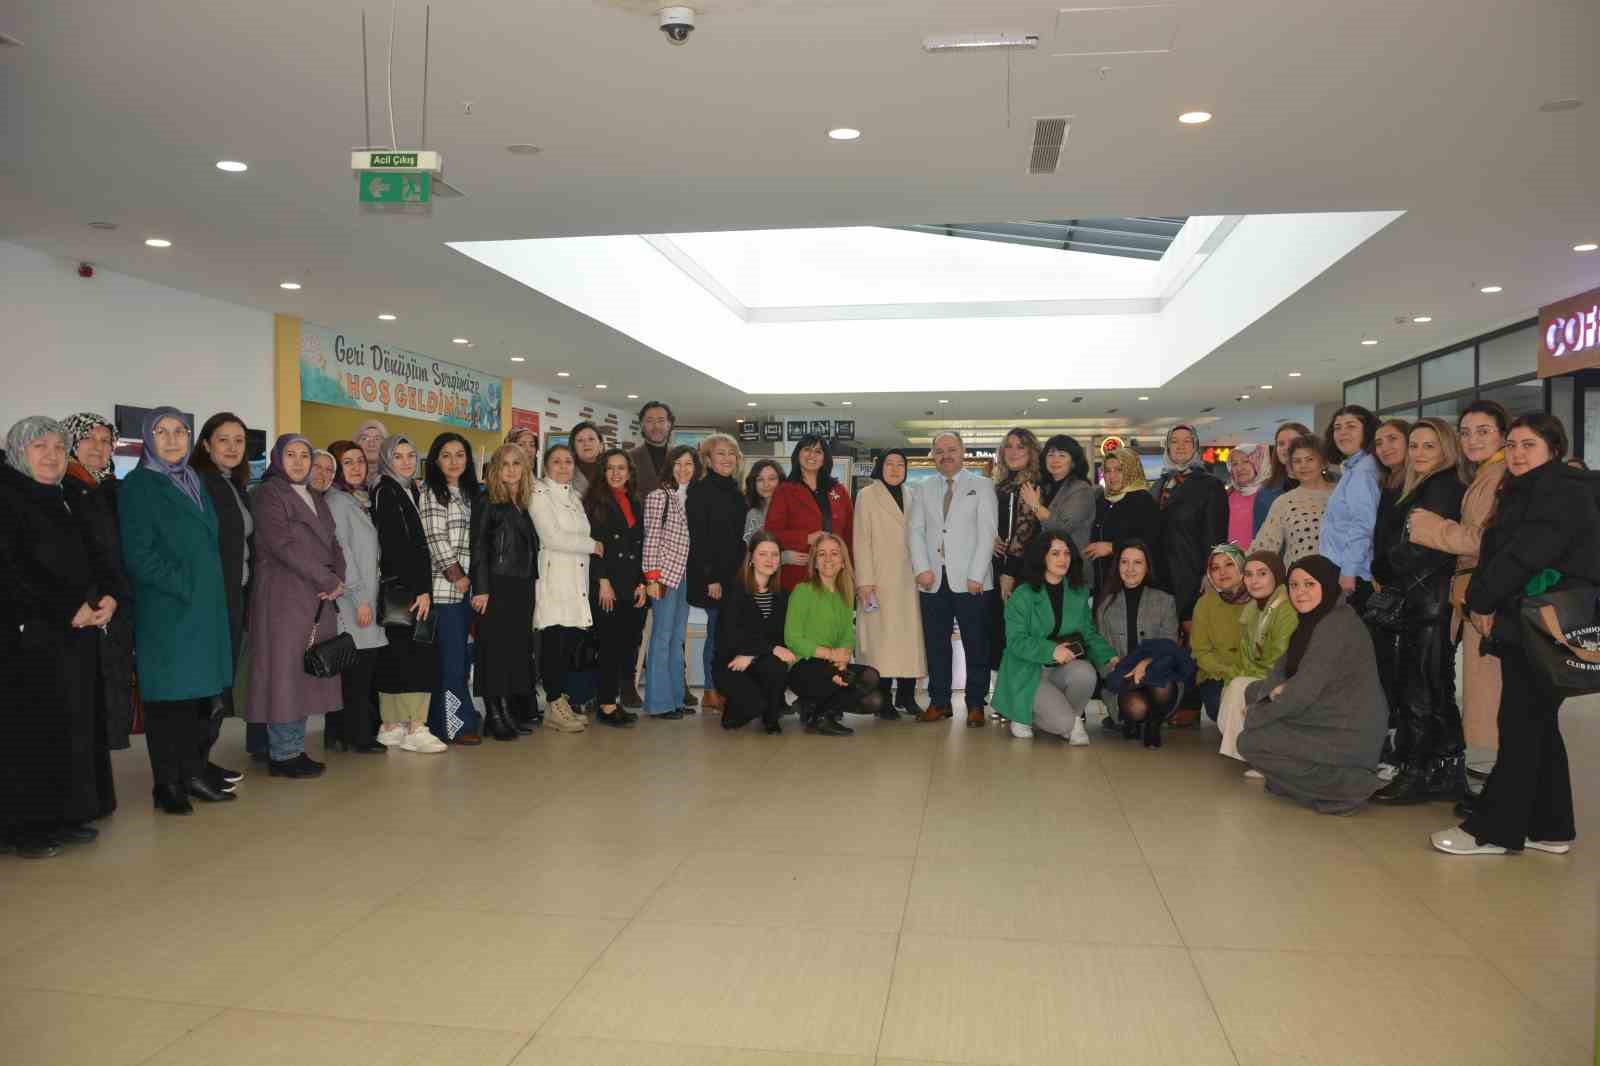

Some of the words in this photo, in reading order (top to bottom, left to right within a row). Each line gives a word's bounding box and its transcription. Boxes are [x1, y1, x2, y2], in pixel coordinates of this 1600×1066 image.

[374, 155, 391, 165] Acil
[393, 155, 415, 166] Çıkış
[1546, 305, 1600, 357] COF
[335, 335, 365, 366] Geri
[370, 345, 429, 384] Dönüşüm
[346, 373, 390, 411] HOŞ
